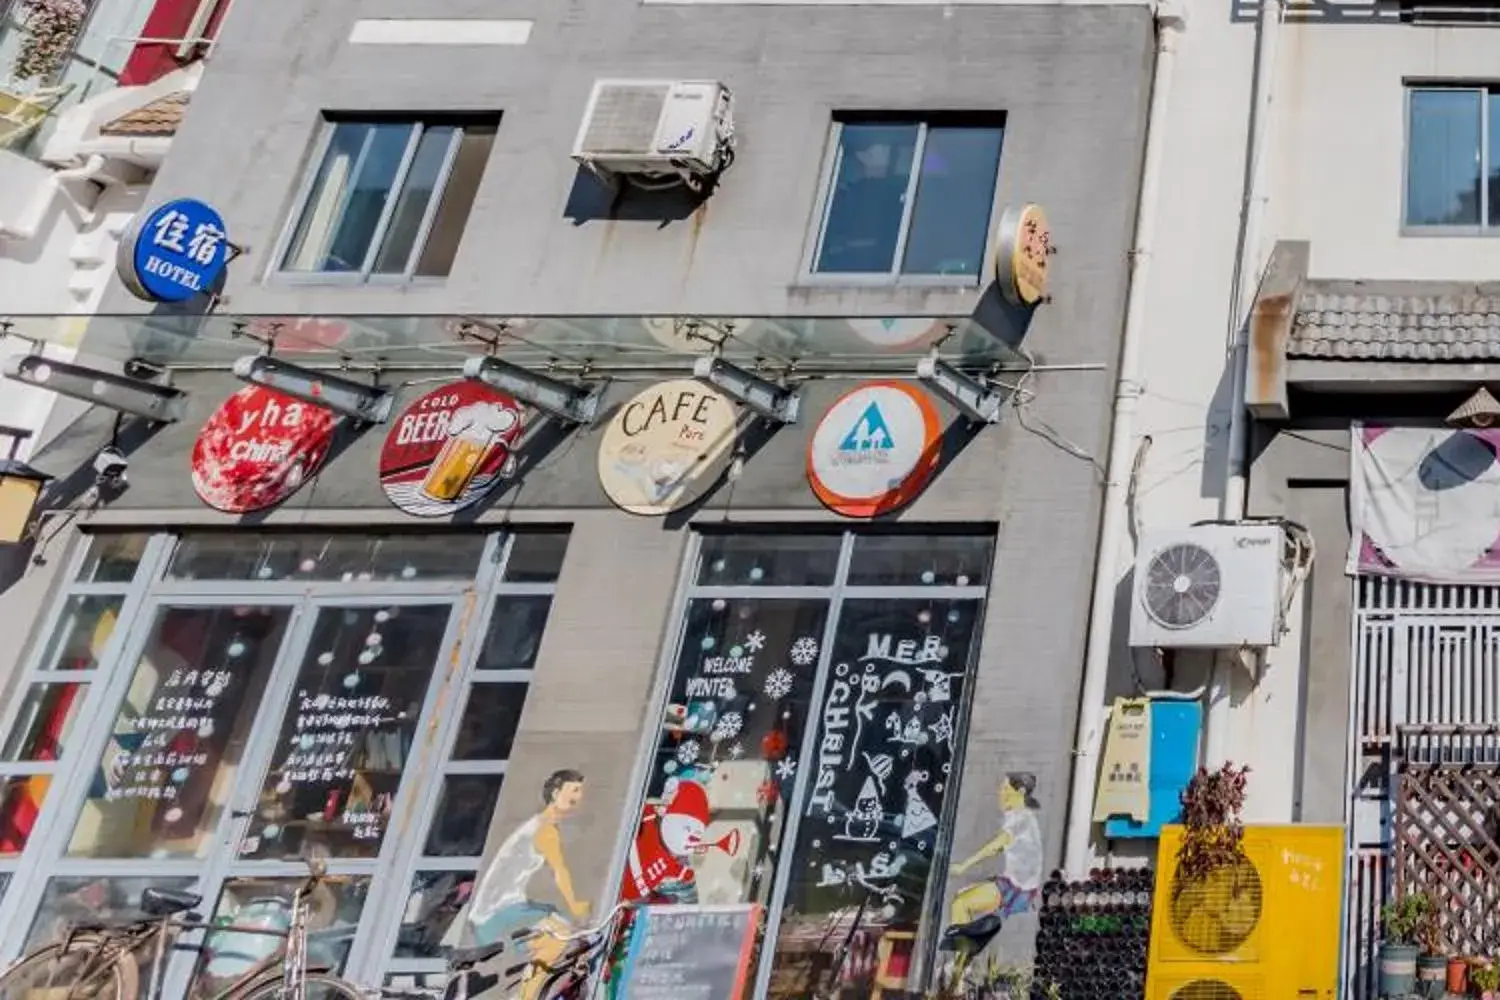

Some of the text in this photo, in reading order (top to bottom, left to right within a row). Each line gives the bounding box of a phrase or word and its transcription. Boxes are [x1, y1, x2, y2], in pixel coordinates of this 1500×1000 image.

[153, 209, 225, 265] 住宿
[144, 255, 201, 291] HOTEL
[236, 399, 303, 435] yha
[420, 394, 460, 409] COLD
[622, 391, 718, 437] CAFE
[396, 412, 452, 446] BEER
[703, 656, 754, 673] WELCOME
[685, 677, 736, 699] WINTER
